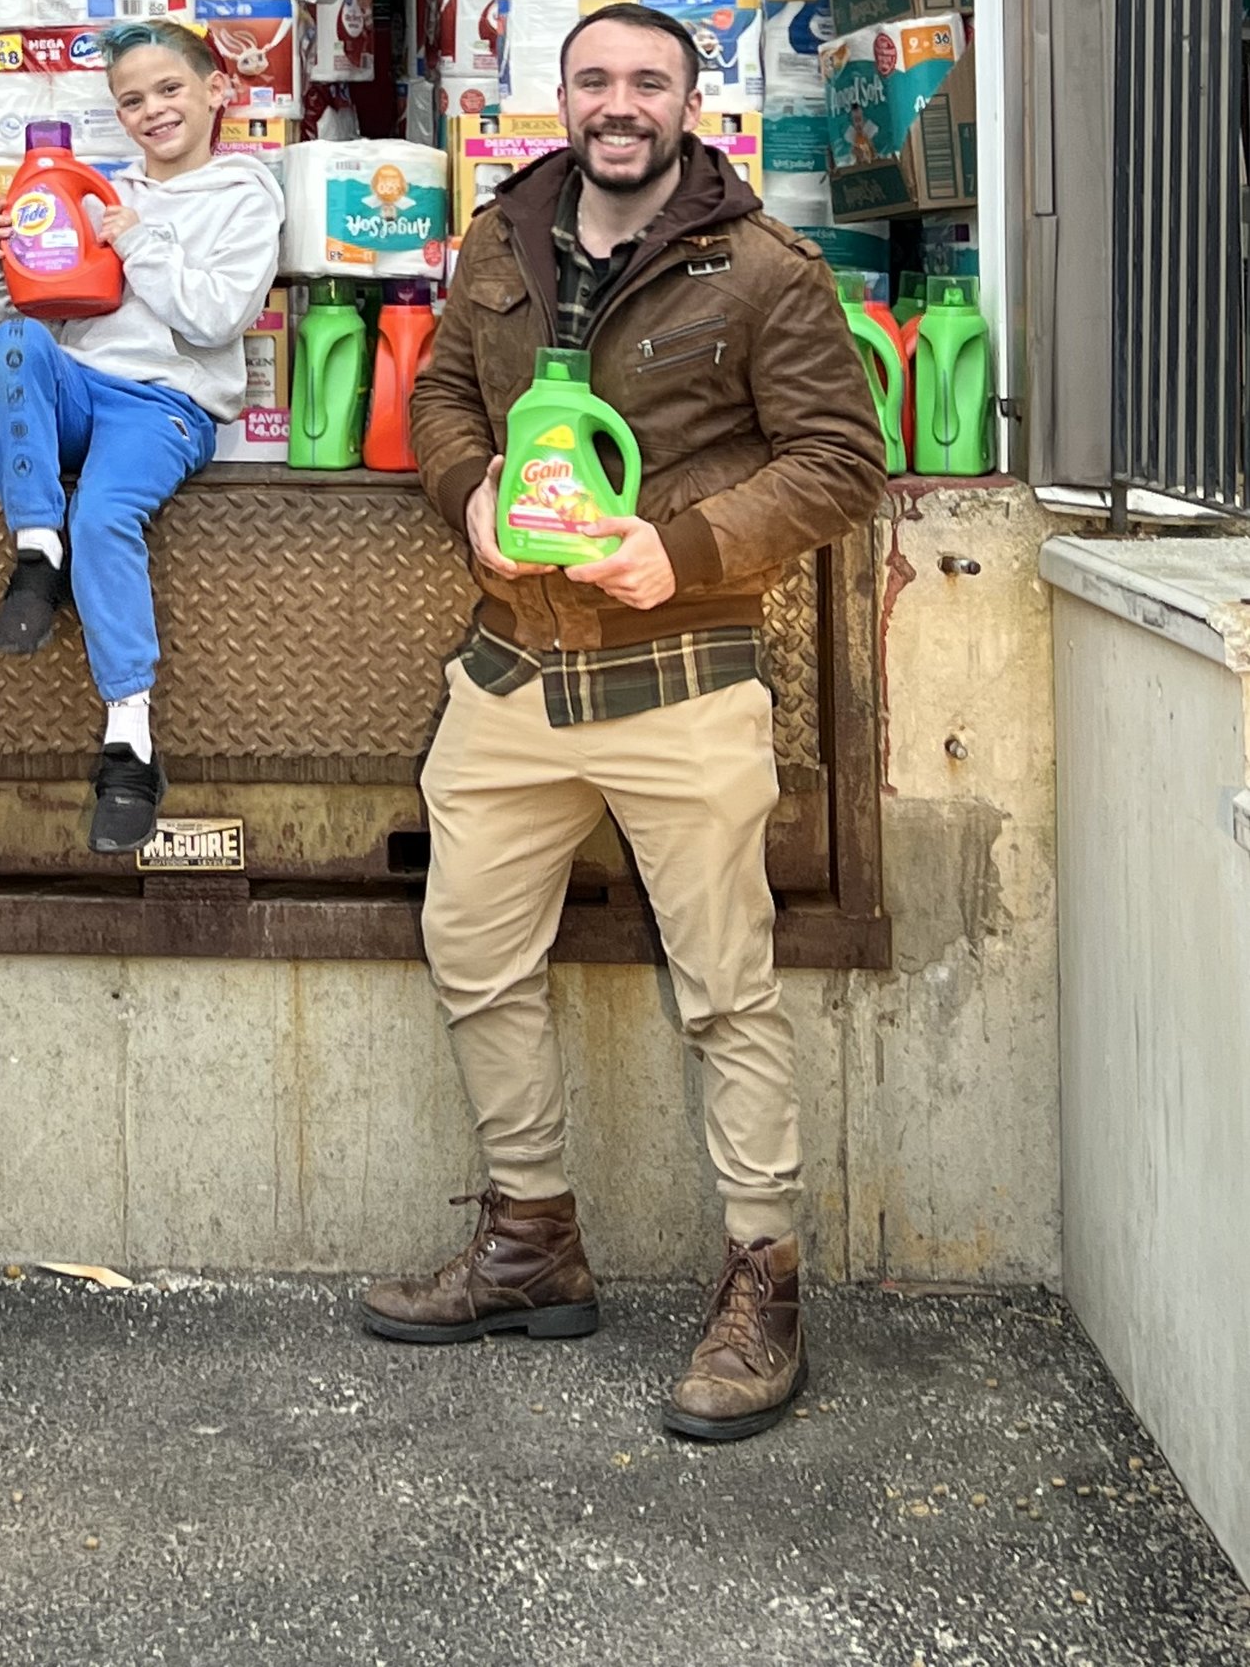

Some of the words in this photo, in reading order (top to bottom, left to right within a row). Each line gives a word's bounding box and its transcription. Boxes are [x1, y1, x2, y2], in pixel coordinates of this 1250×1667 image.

[28, 38, 65, 50] MEGA
[907, 36, 920, 49] 9
[934, 31, 950, 44] 36
[511, 119, 558, 131] JERGENS
[484, 138, 525, 148] DEEPLY
[492, 148, 526, 158] EXTRA
[17, 203, 49, 229] Tide
[345, 214, 381, 238] Soft
[381, 217, 432, 239] Angel
[249, 413, 283, 424] SAVE
[524, 460, 570, 483] Gain
[143, 828, 238, 857] McGUIRE
